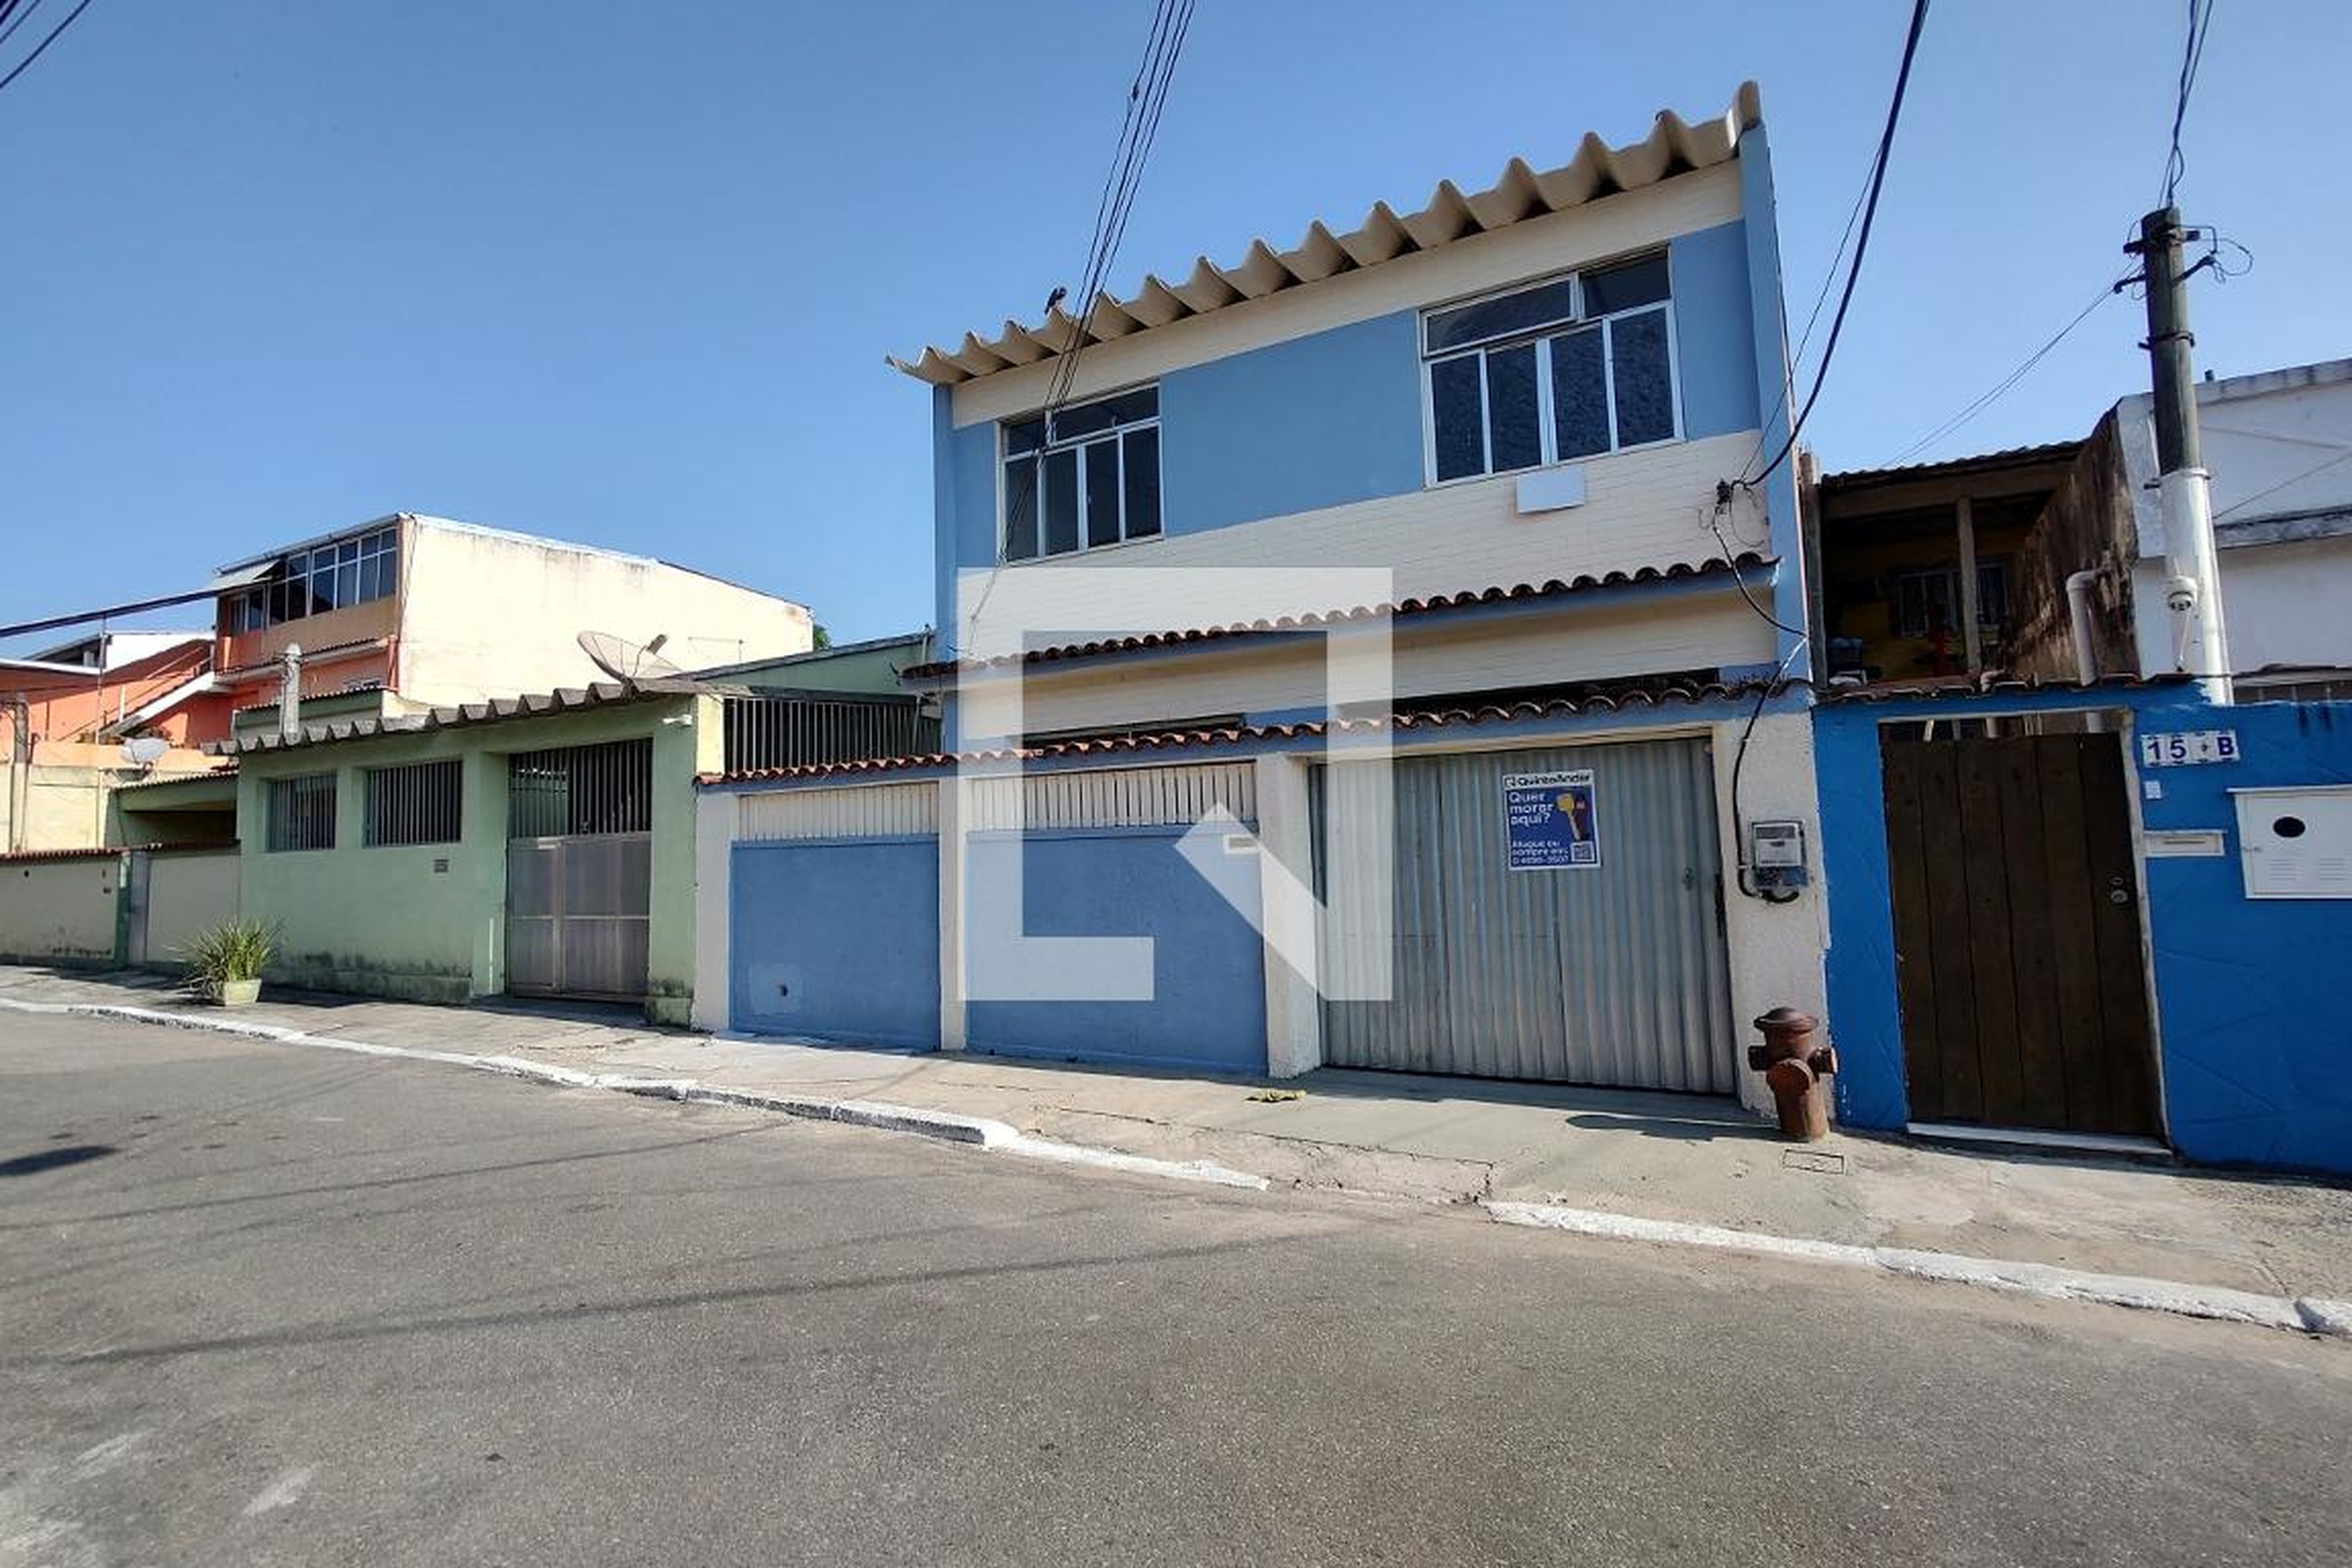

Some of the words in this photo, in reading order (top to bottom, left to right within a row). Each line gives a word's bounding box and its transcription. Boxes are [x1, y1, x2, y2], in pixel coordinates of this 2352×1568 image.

[2147, 739, 2187, 760] 15
[2217, 737, 2234, 756] B
[1509, 792, 1545, 803] Quer
[1510, 804, 1553, 814] morar
[1510, 812, 1551, 827] aqui?
